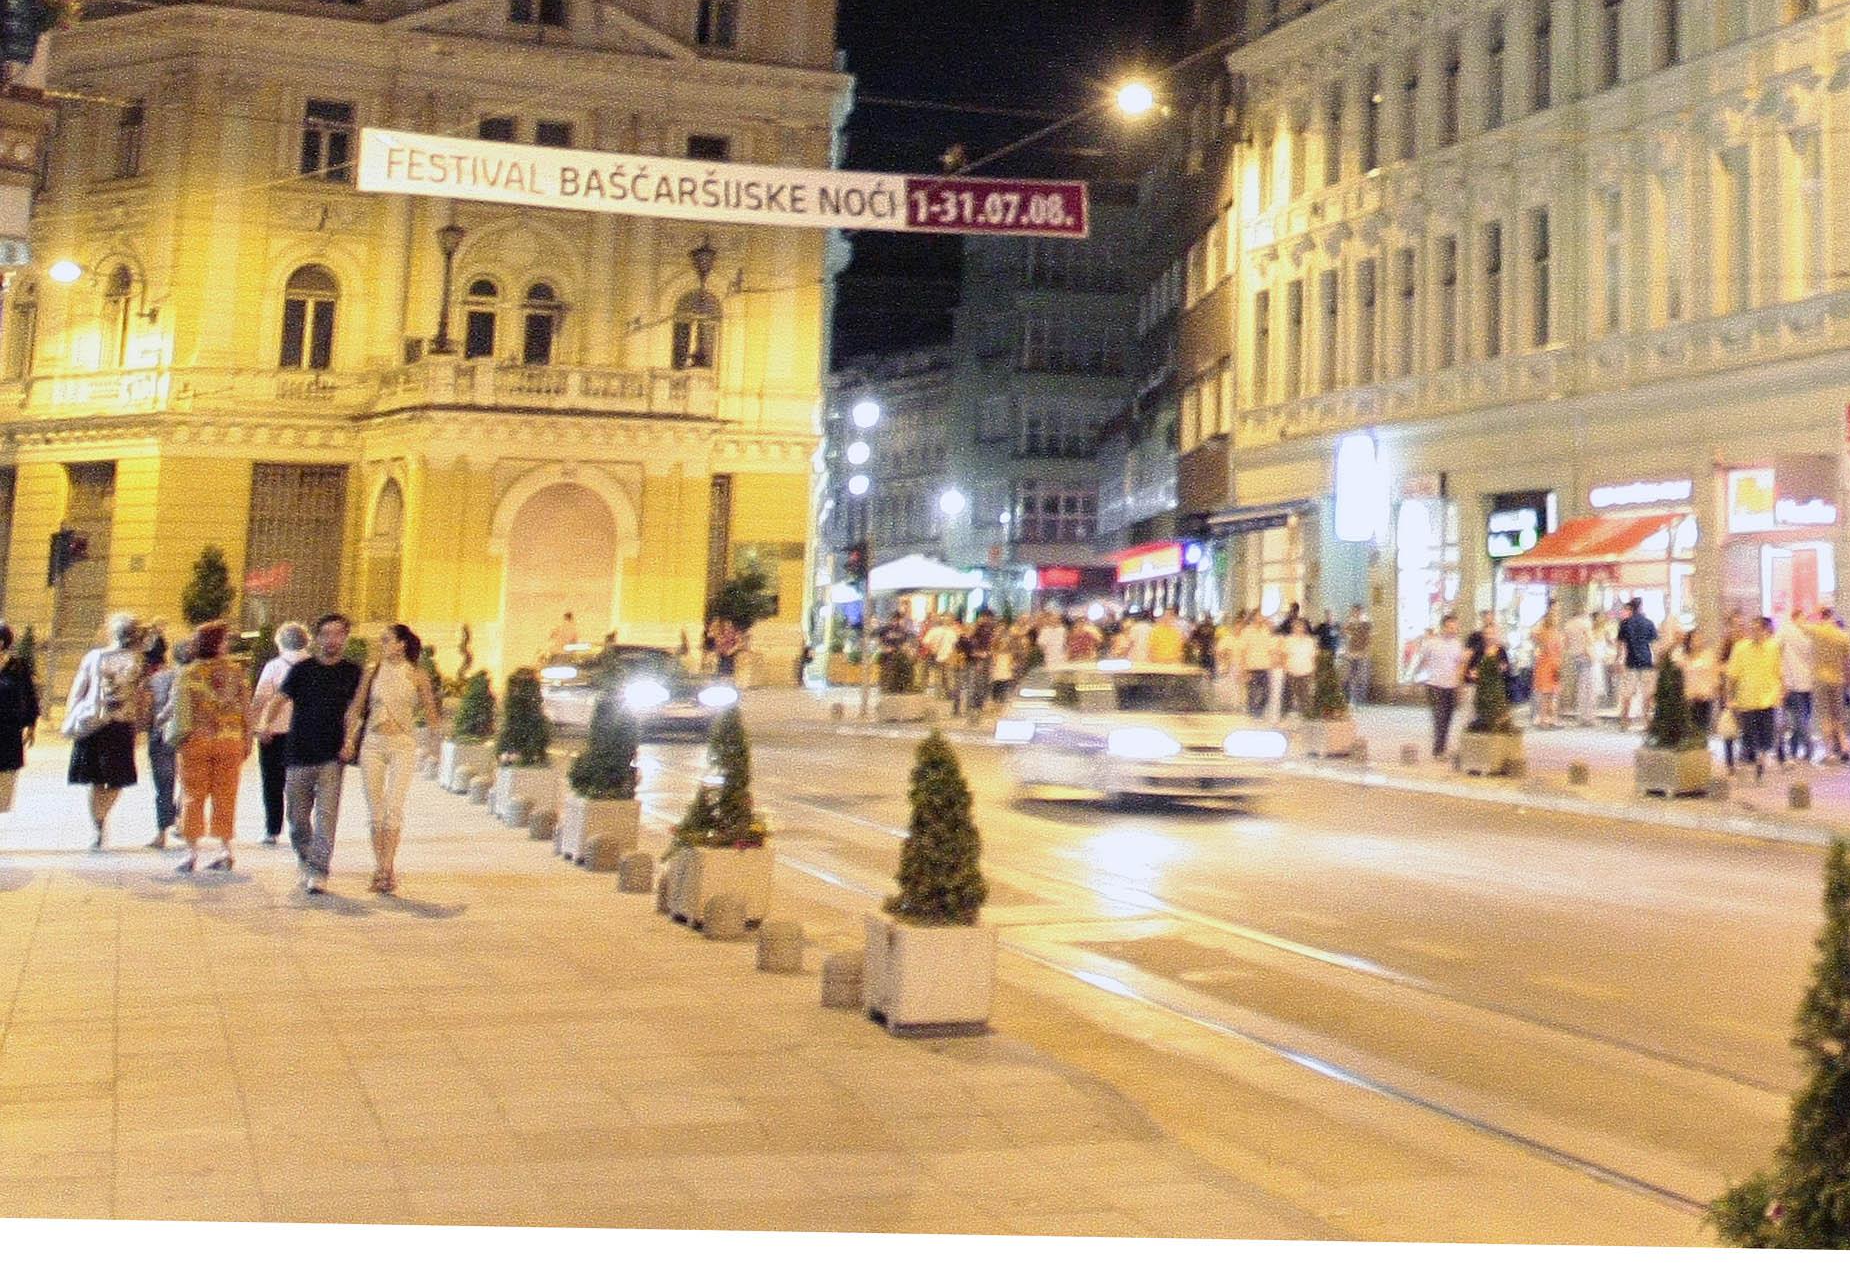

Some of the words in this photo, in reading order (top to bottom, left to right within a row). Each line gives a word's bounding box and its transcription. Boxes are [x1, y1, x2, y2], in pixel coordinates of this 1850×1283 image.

[386, 148, 547, 195] FESTIVAL
[559, 164, 807, 213] BAŠČARŠIJSKE
[818, 178, 896, 218] NOĆI
